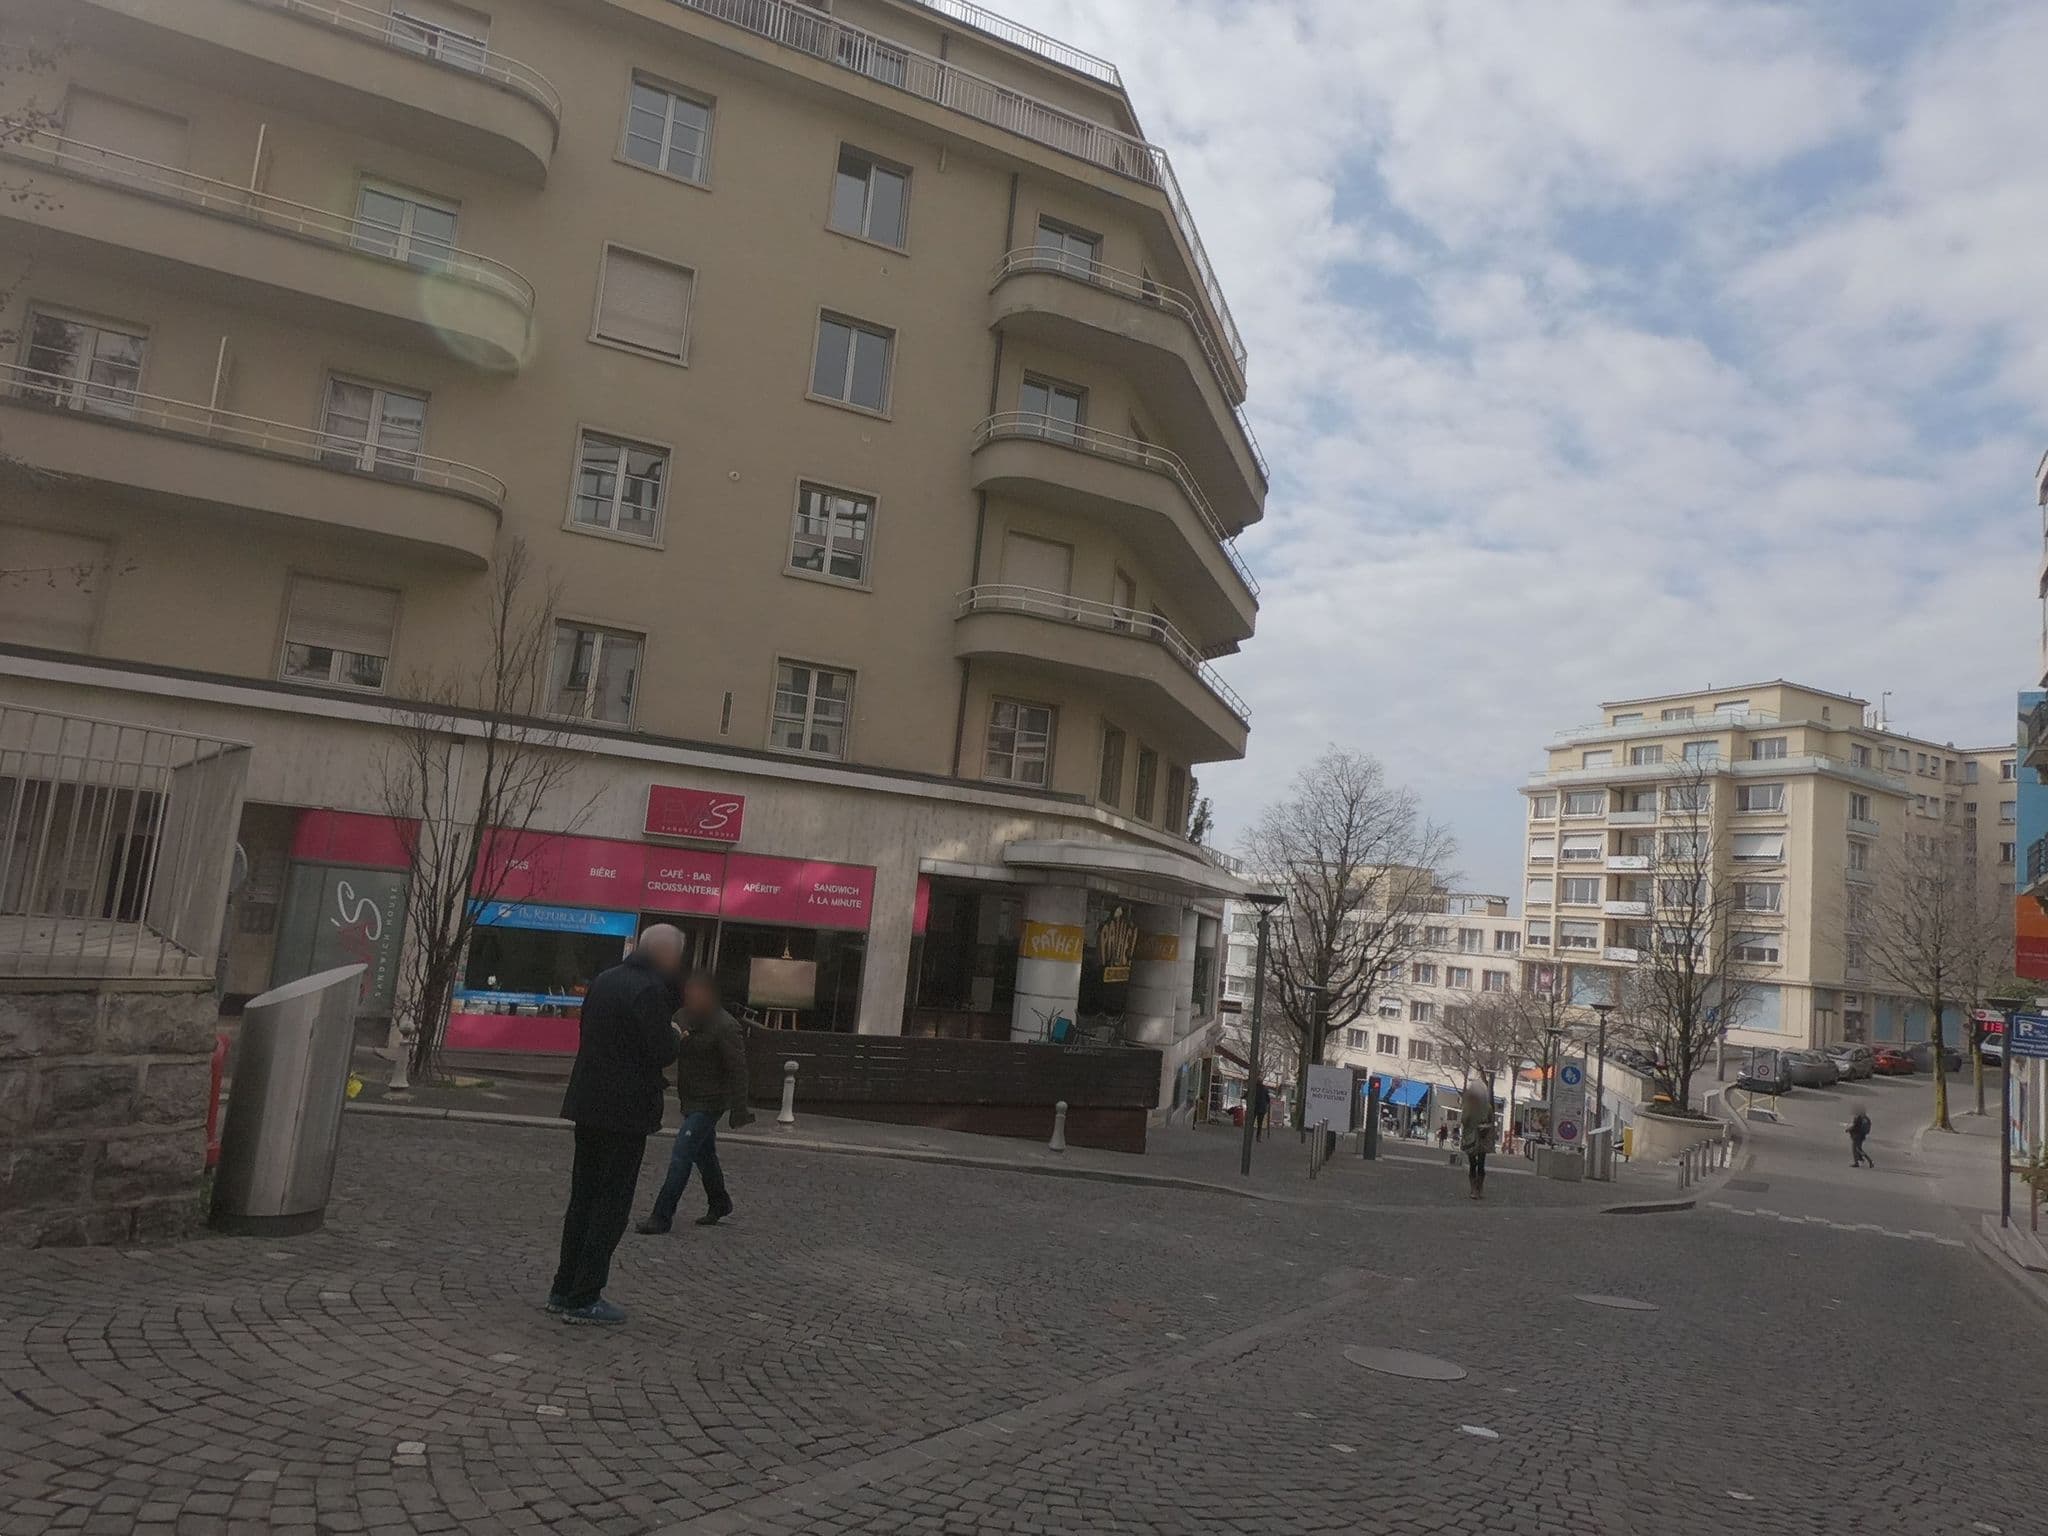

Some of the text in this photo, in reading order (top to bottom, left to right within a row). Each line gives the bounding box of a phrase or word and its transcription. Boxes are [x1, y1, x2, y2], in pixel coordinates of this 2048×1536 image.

[589, 866, 617, 879] BIÈRE
[659, 867, 712, 881] CAFÉ BAR
[647, 880, 720, 897] CROISSANTERIE
[743, 882, 782, 895] APÉRITIF
[813, 883, 860, 896] SANDWICH
[816, 896, 828, 906] LA
[830, 897, 862, 909] MINUTE
[374, 886, 399, 998] SANDWICH HOUSE
